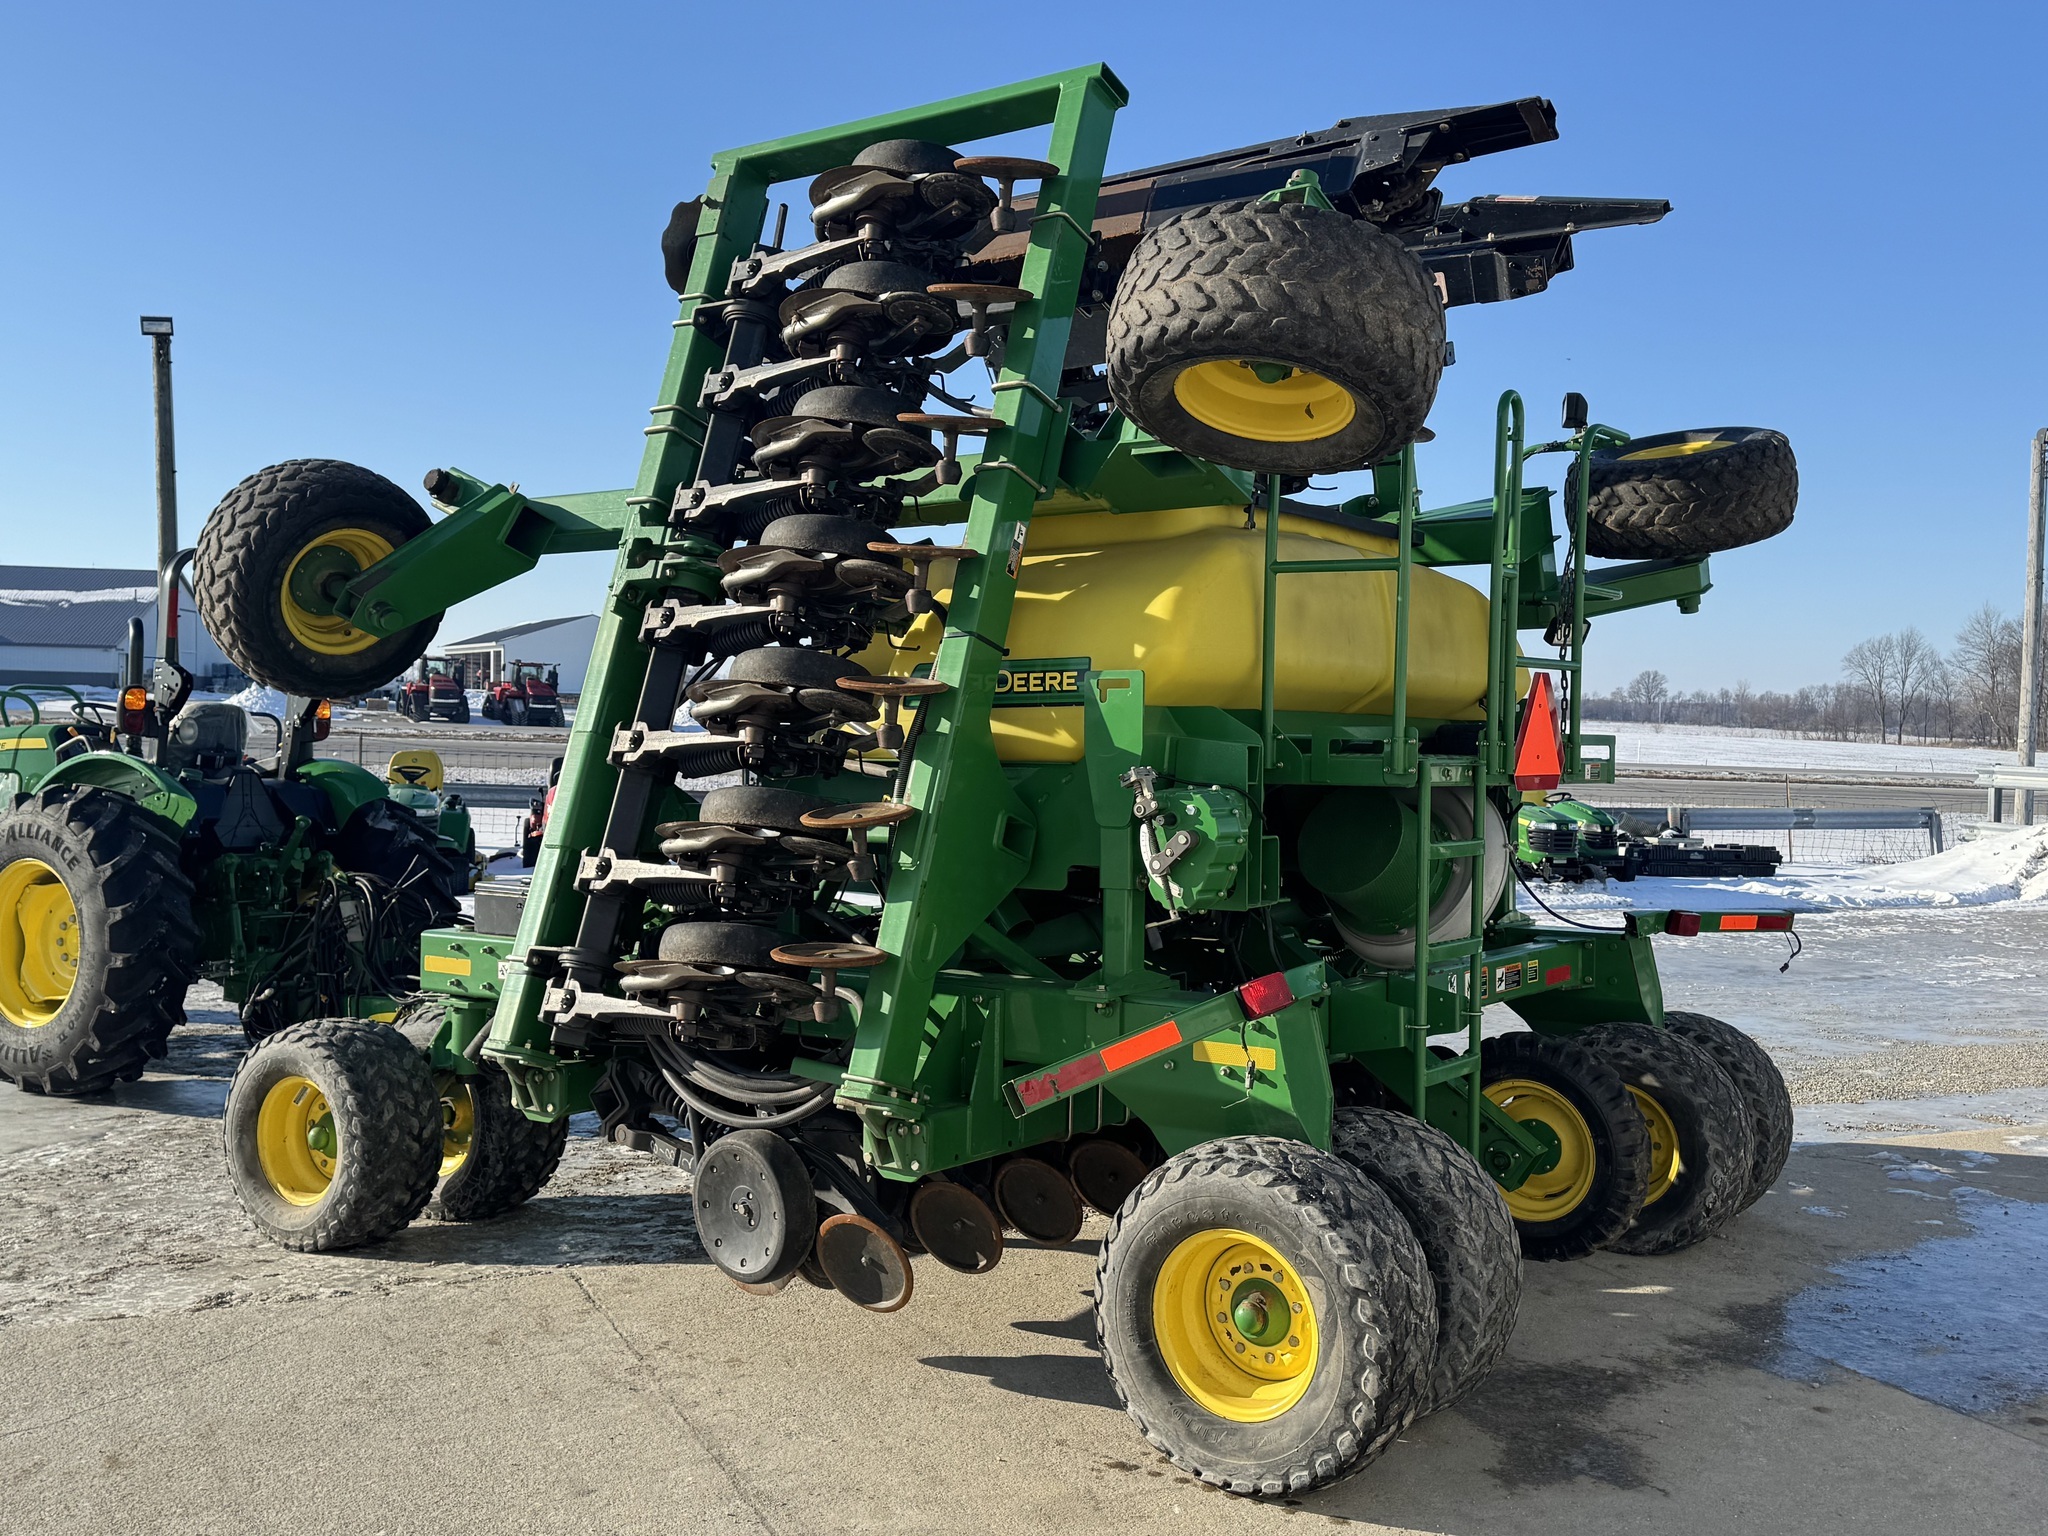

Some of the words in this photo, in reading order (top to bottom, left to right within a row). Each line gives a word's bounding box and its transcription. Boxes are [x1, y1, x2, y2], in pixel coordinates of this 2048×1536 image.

[995, 670, 1078, 693] DEERE
[6, 822, 81, 872] ALLIANCE
[1145, 1207, 1287, 1248] Firestone
